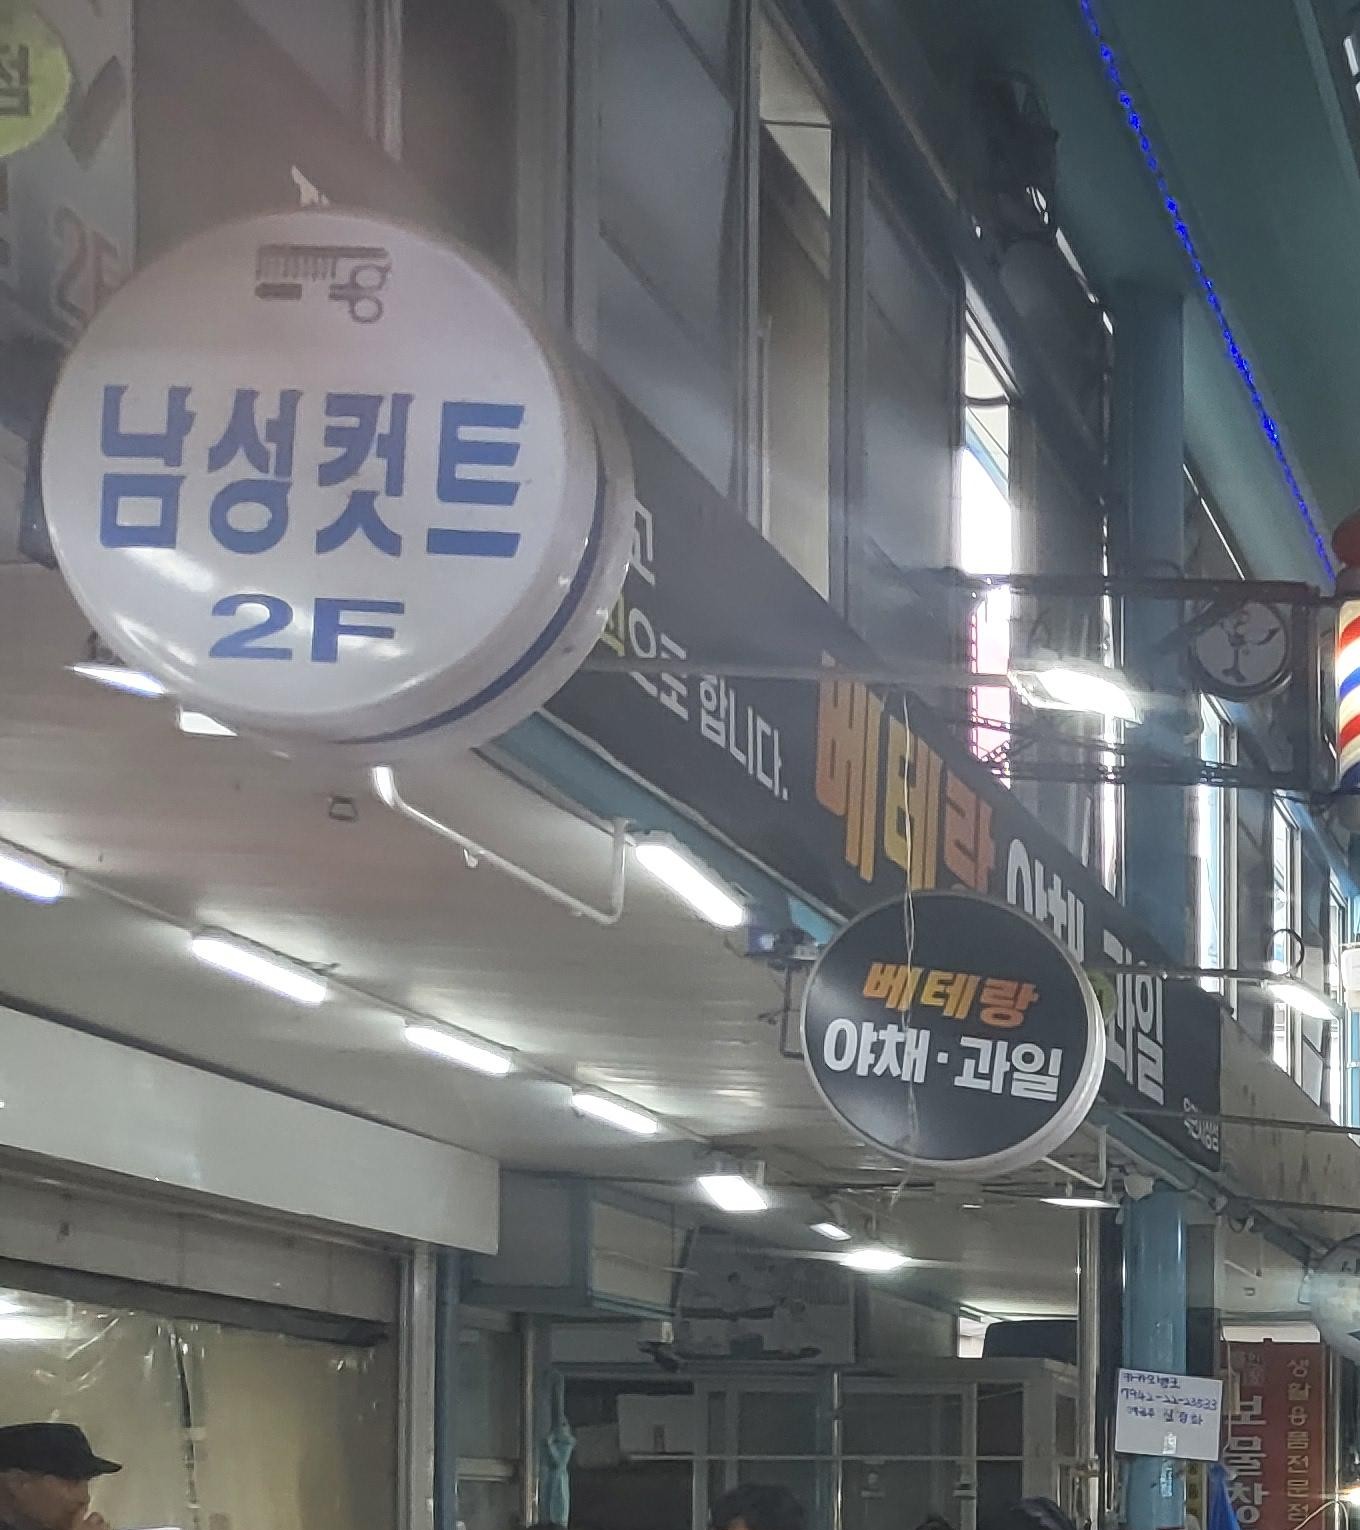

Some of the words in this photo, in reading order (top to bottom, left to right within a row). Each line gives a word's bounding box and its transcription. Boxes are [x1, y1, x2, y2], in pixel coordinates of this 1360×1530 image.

[100, 384, 526, 557] 남성컷트
[208, 593, 406, 663] 2F
[862, 961, 1039, 1028] 베테랑
